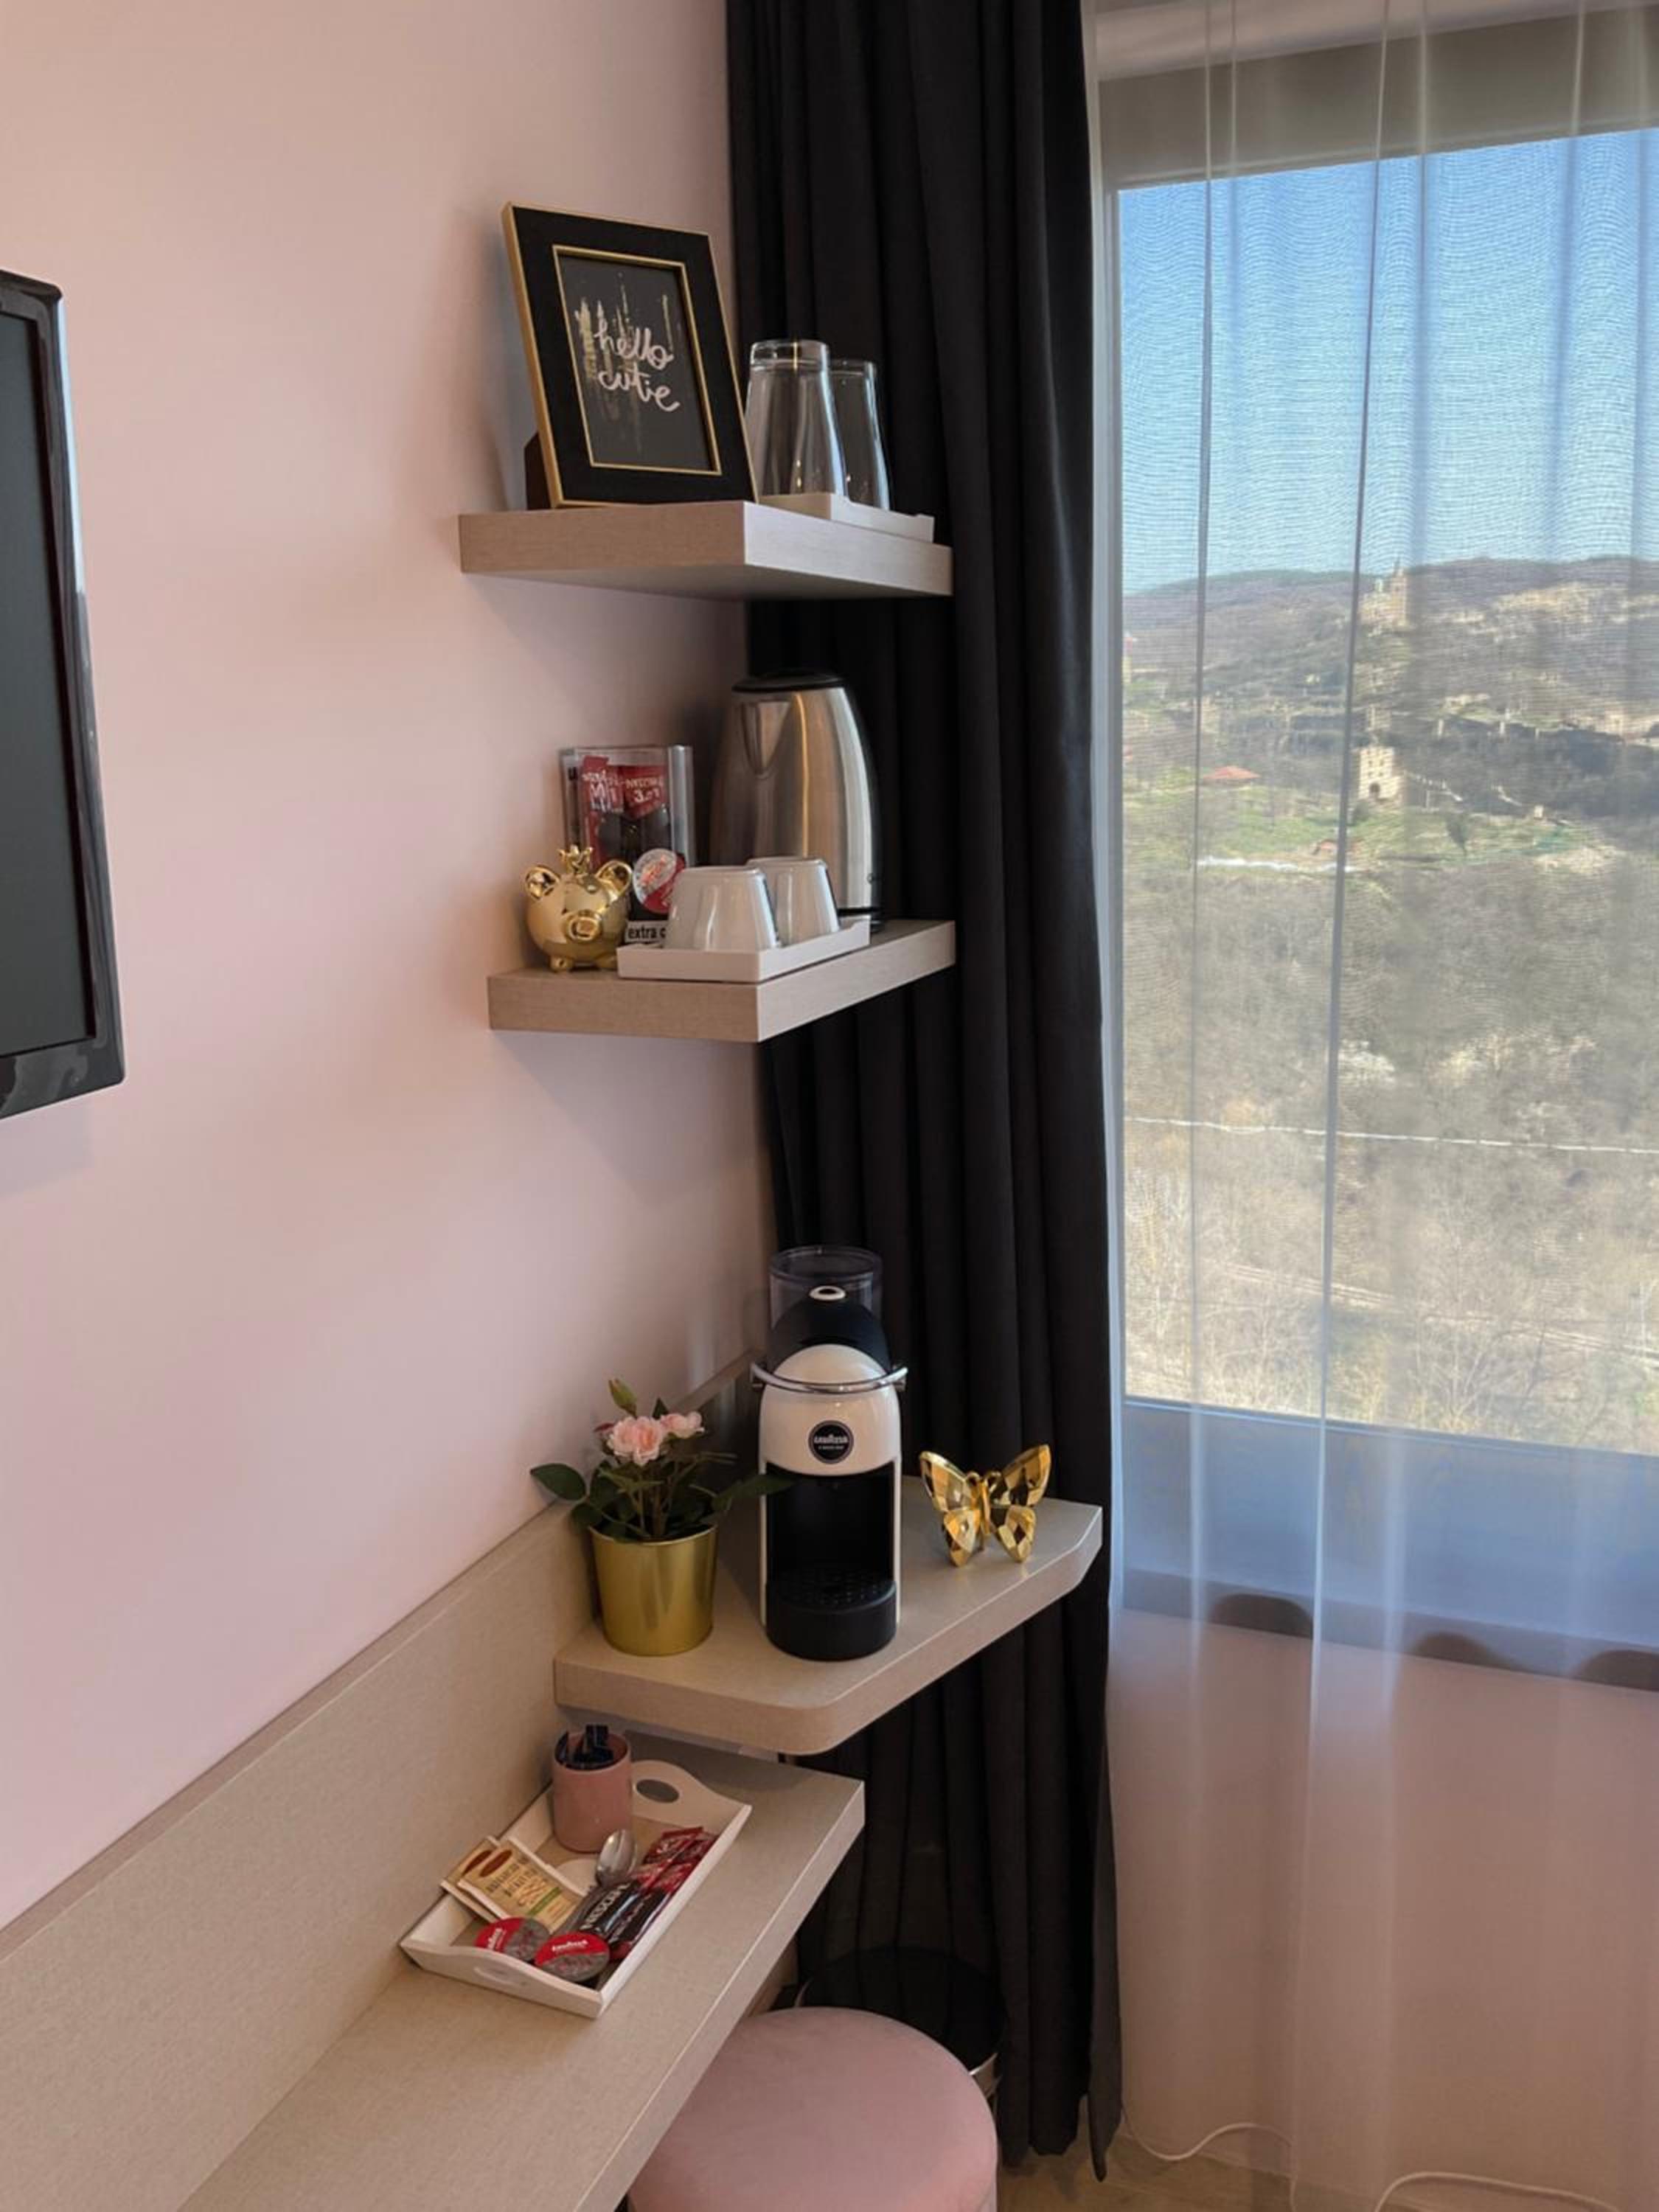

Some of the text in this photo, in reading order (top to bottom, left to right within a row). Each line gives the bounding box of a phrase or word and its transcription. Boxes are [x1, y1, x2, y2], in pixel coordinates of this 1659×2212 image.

[594, 318, 675, 370] hello
[598, 361, 681, 411] cutie
[627, 926, 657, 939] extra
